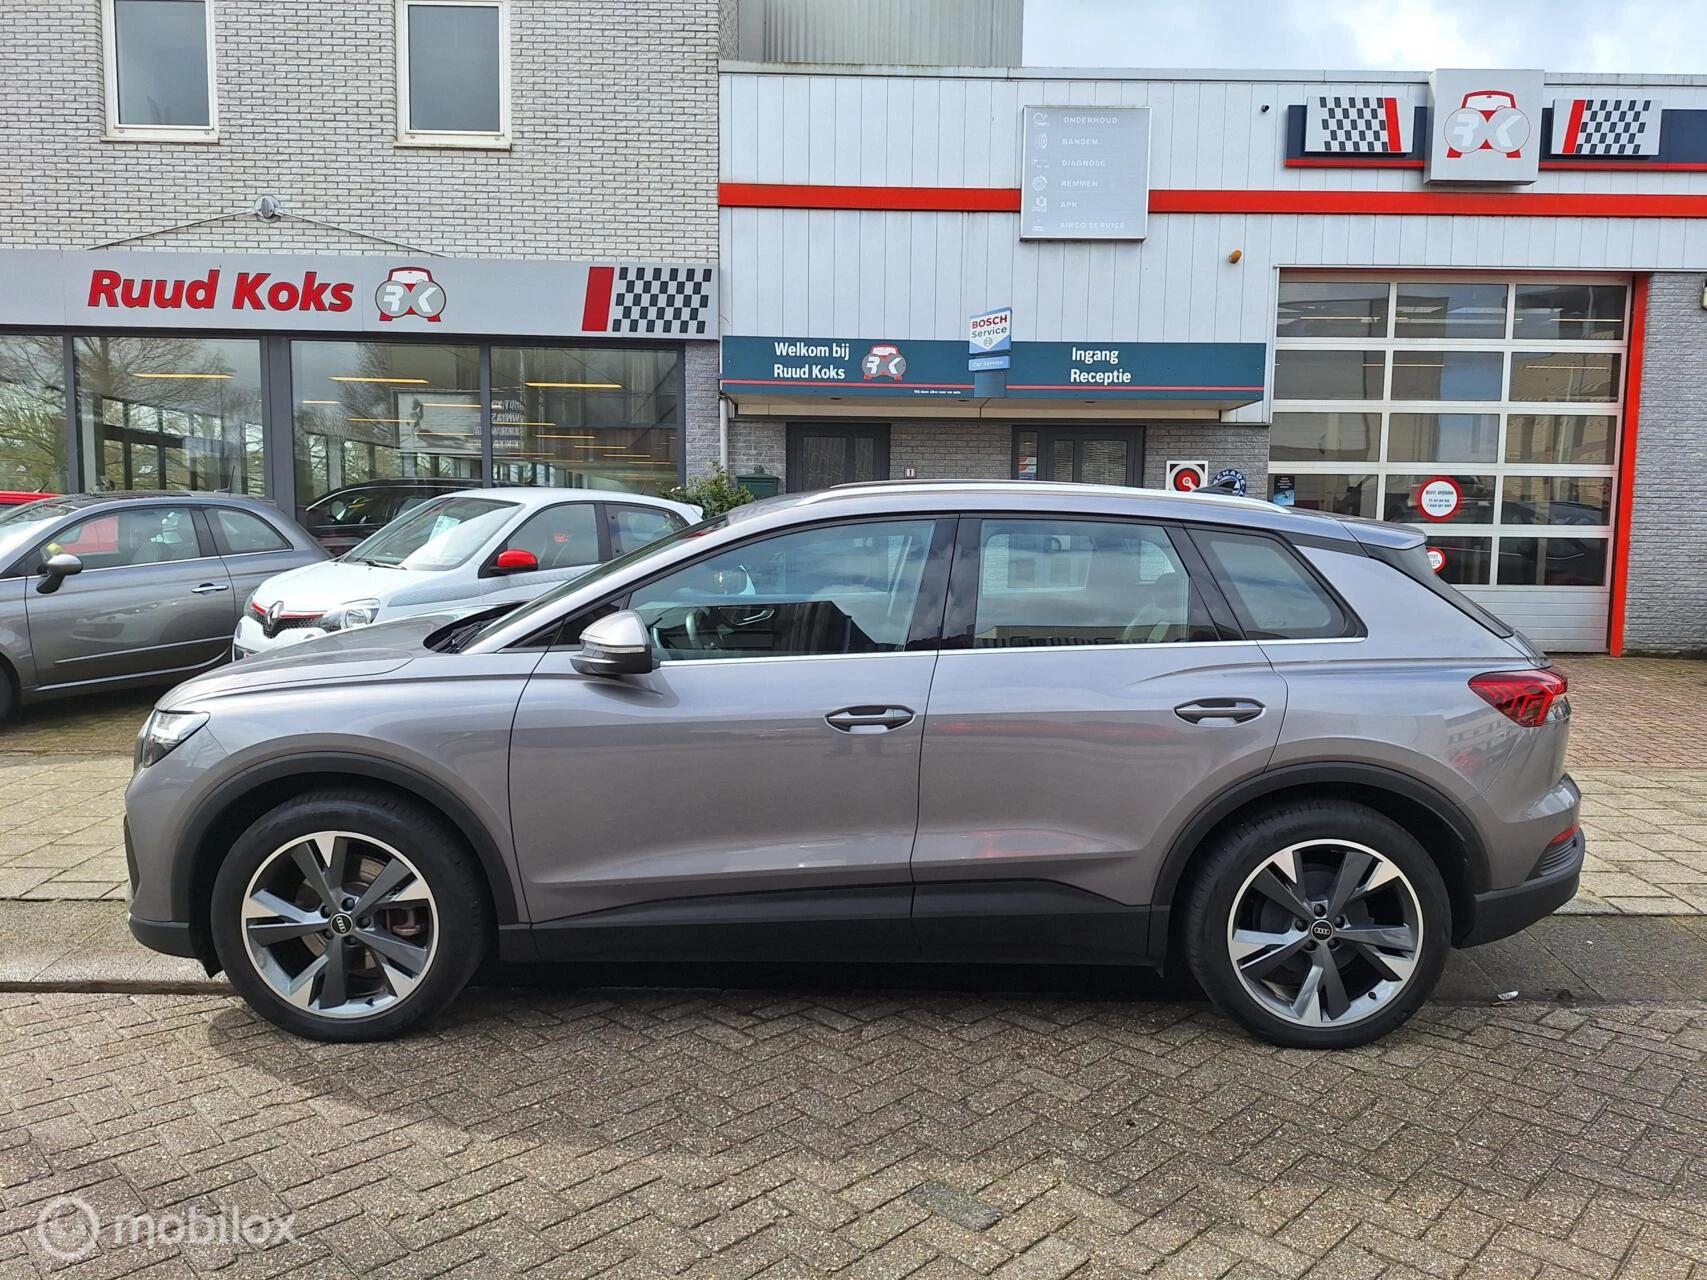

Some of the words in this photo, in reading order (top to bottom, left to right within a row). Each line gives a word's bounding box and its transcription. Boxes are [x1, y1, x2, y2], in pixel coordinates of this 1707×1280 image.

[1063, 116, 1118, 124] ONDERHOUD
[87, 269, 220, 310] Ruud
[232, 271, 354, 312] Koks
[971, 314, 1008, 329] BOSCH
[971, 326, 1008, 338] Service
[774, 342, 829, 357] Welkom
[832, 342, 850, 360] bij
[1072, 347, 1119, 364] Ingang
[773, 363, 809, 378] Ruud
[812, 365, 846, 379] Koks
[1070, 368, 1132, 386] Receptie
